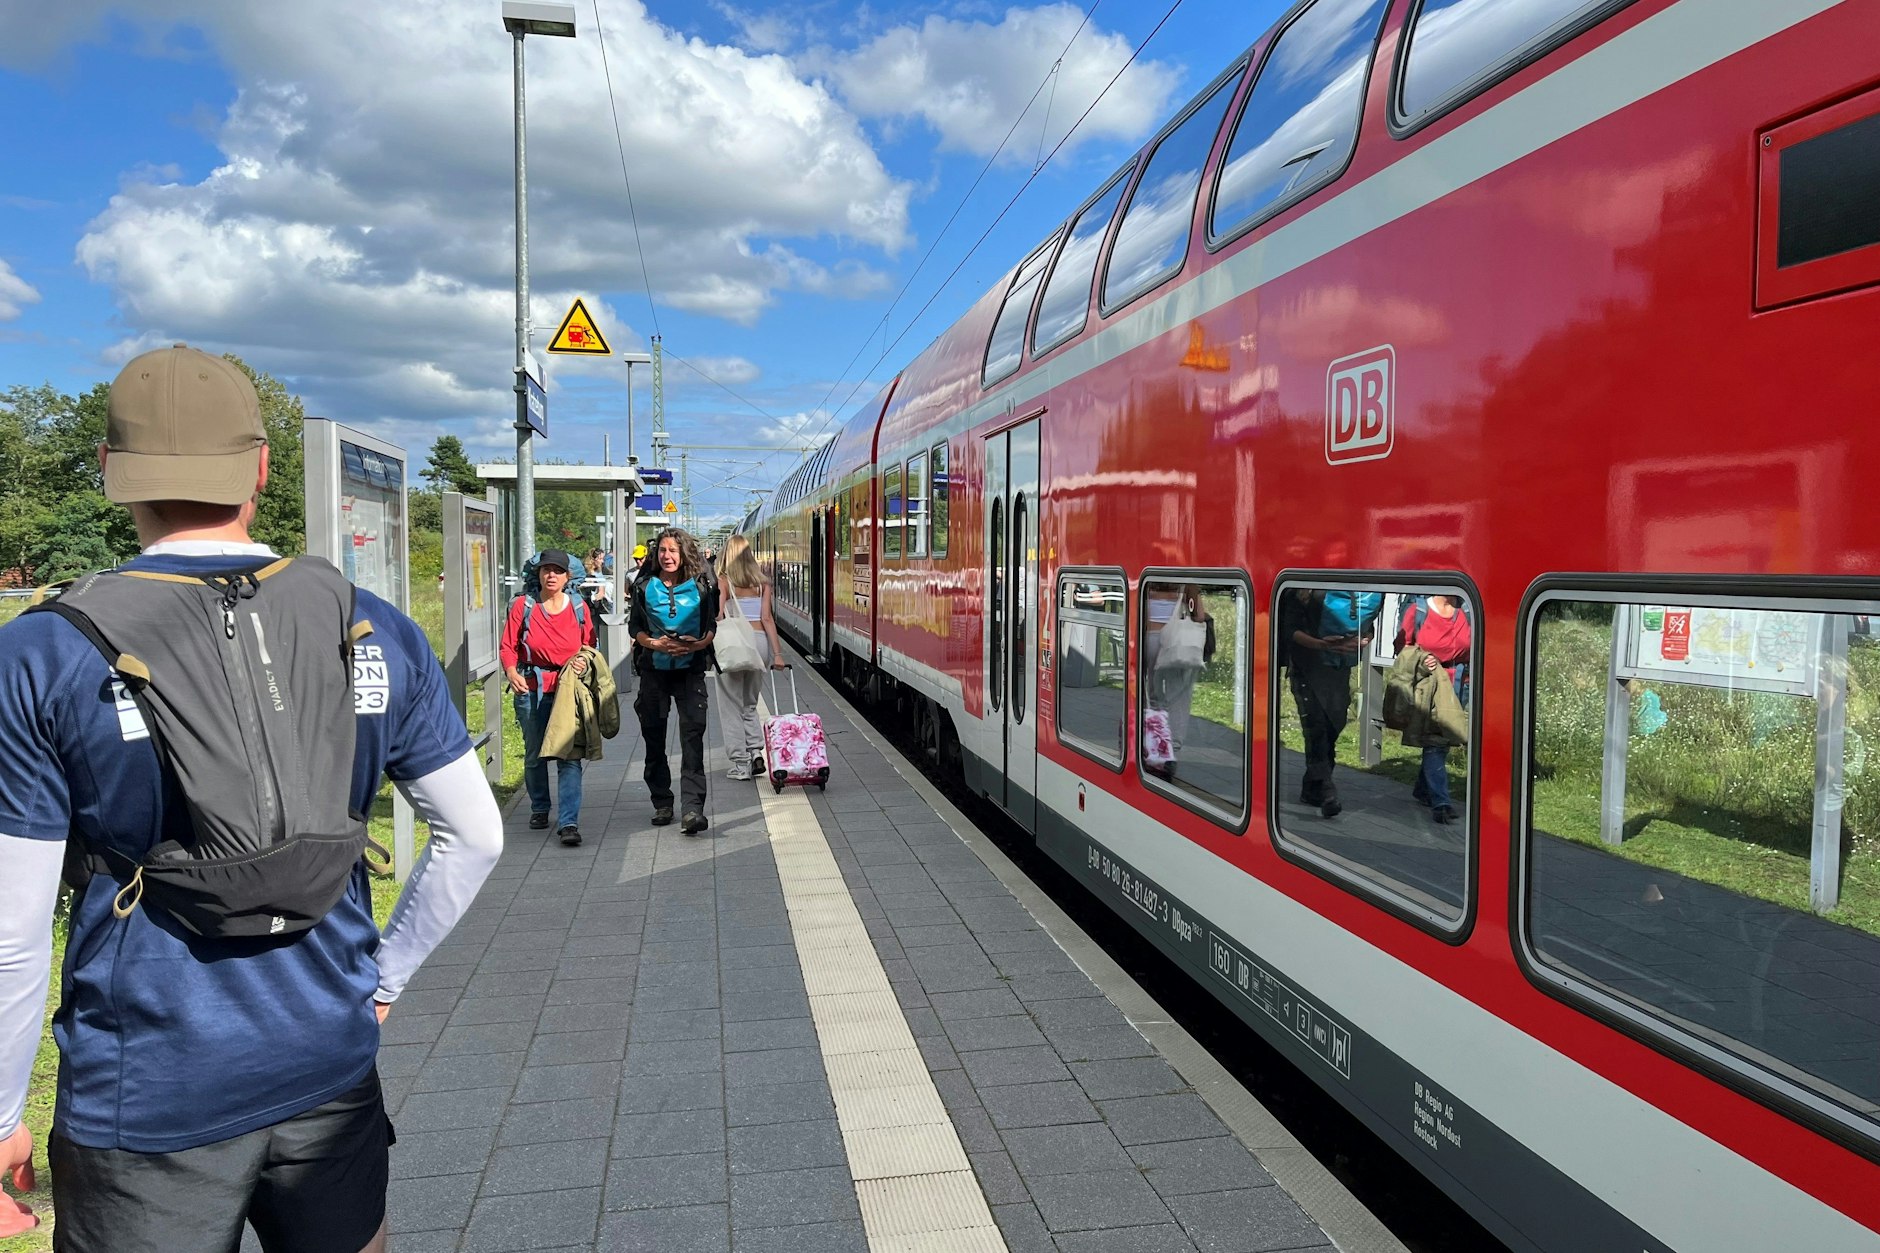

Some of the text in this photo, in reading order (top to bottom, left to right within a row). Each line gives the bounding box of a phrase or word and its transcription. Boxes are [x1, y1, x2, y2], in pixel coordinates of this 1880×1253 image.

[1333, 366, 1385, 446] DB
[1043, 588, 1051, 639] 2
[266, 669, 284, 712] EVADICT
[1102, 856, 1111, 878] 50
[1112, 863, 1121, 886] 80
[1172, 907, 1192, 943] DBpza
[1213, 942, 1230, 975] 160
[1238, 960, 1249, 990] DB
[1301, 1014, 1306, 1029] 3
[1415, 1081, 1454, 1121] DB Regio AG
[1415, 1101, 1461, 1149] Region Nordost
[1414, 1120, 1438, 1150] Rostock
